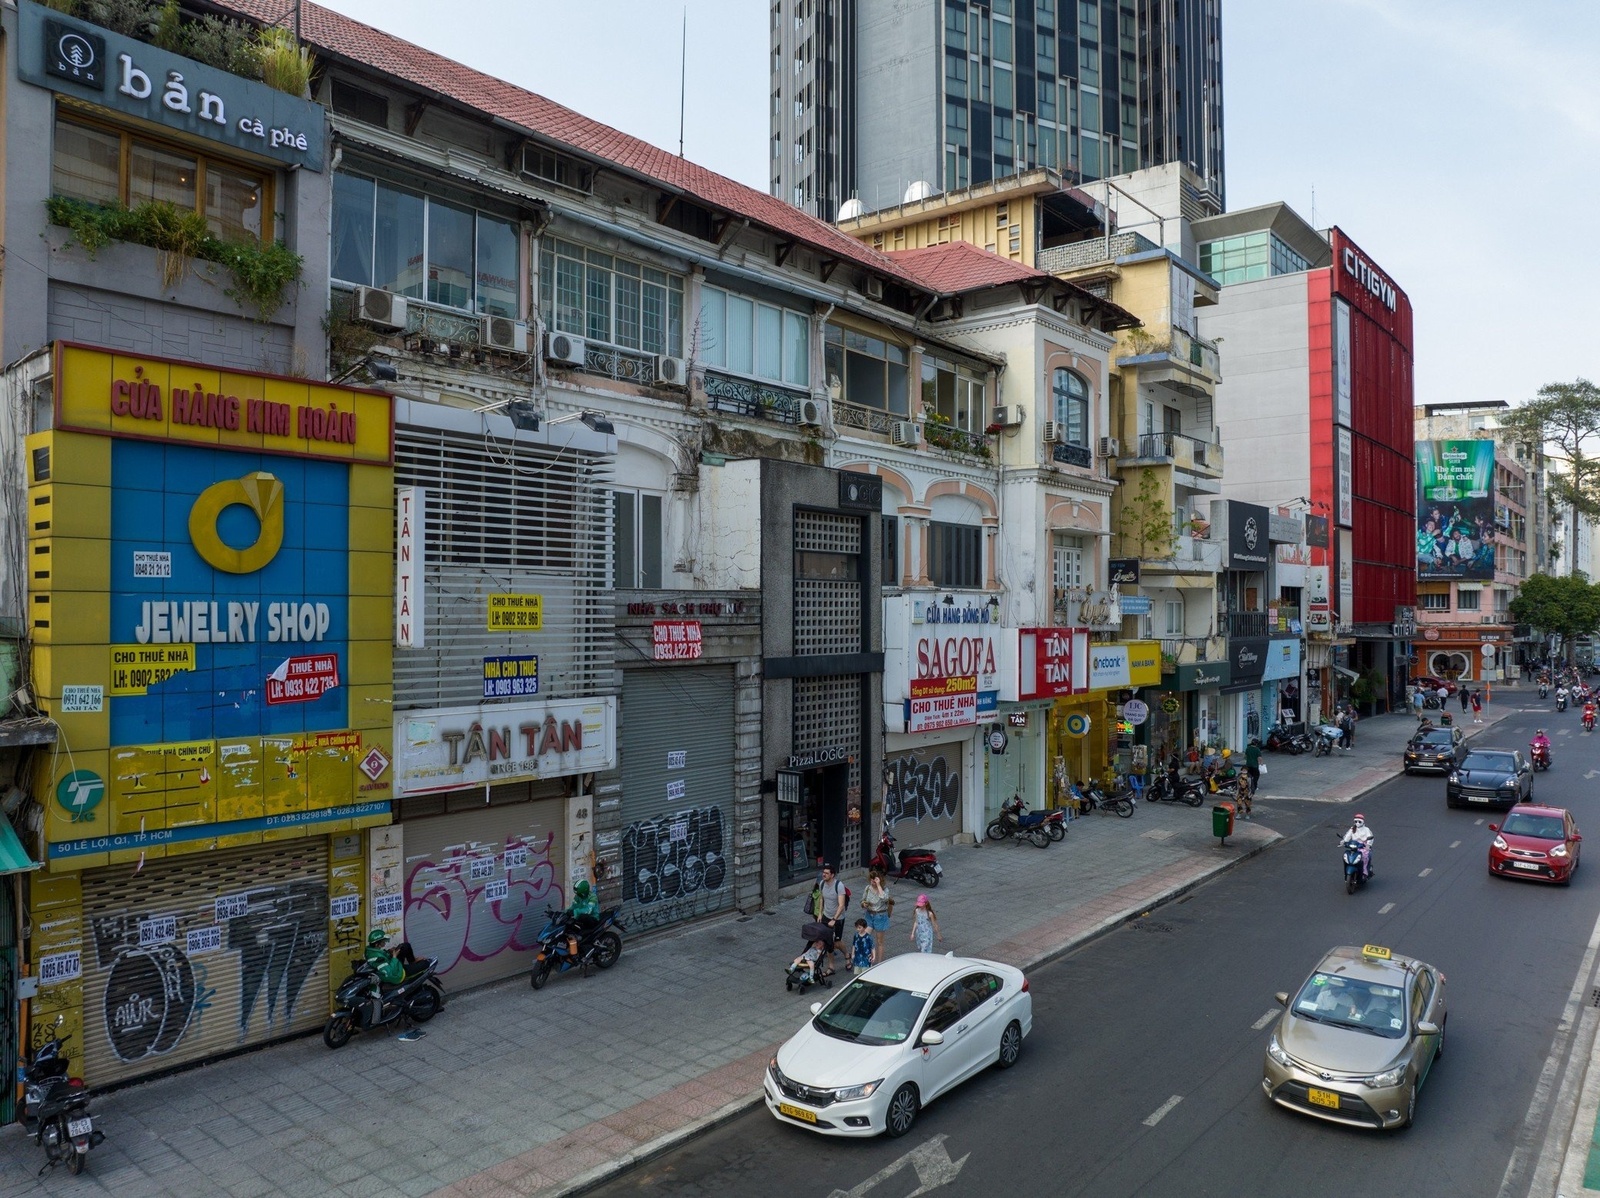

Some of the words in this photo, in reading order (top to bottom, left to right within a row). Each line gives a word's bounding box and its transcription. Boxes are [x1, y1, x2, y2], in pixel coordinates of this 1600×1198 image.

[119, 54, 227, 125] bản
[238, 116, 265, 138] cà
[269, 127, 308, 152] phê
[1343, 247, 1397, 313] CITIGYM
[111, 365, 163, 421] CỬA
[172, 384, 239, 431] HÀNG
[247, 398, 290, 436] KIM
[297, 402, 357, 444] HOÀN
[1434, 466, 1449, 474] Nhẹ
[401, 497, 411, 562] TÂN
[146, 553, 158, 561] THUÊ
[400, 574, 410, 642] TÂN
[492, 597, 506, 606] CHO
[507, 596, 523, 606] THUÊ
[525, 597, 538, 607] NHÀ
[135, 600, 260, 644] JEWELRY
[267, 602, 330, 643] SHOP
[654, 625, 667, 641] CHO
[669, 622, 685, 641] THUÊ
[686, 621, 701, 641] NHÀ
[1044, 632, 1069, 657] TÂN
[114, 651, 136, 663] CHO
[139, 649, 164, 662] THUÊ
[167, 648, 189, 661] NHÀ
[917, 637, 997, 679] SAGOFA
[1145, 659, 1155, 667] BANK
[291, 660, 313, 674] THUÊ
[315, 658, 333, 671] NHÀ
[485, 658, 501, 678] NHÀ
[502, 661, 518, 677] CHO
[519, 657, 537, 676] THUÊ
[1044, 658, 1069, 683] TÂN
[114, 669, 128, 688] LH:
[130, 668, 151, 687] 0902
[271, 681, 284, 699] LH:
[284, 679, 303, 697] 0933
[305, 677, 319, 694] 422
[496, 679, 511, 695] 0903
[513, 679, 524, 694] 963
[525, 678, 537, 693] 325
[946, 677, 976, 692] 250m2
[63, 694, 78, 705] 0931
[79, 694, 90, 705] 642
[91, 694, 101, 704] 166
[77, 686, 90, 694] THUÊ
[913, 702, 931, 714] CHO
[934, 696, 954, 711] THUÊ
[958, 694, 974, 708] NHÀ
[1011, 714, 1025, 723] TÂN
[178, 745, 198, 755] CHÍNH
[199, 743, 211, 754] CHỦ
[293, 737, 304, 748] CHO
[305, 736, 317, 748] THUÊ
[319, 734, 330, 746] NHÀ
[330, 732, 345, 745] CHÍNH
[346, 731, 357, 744] CHỦ
[442, 720, 511, 765] TÂN
[520, 713, 583, 756] TÂN
[789, 755, 814, 767] Pizza
[267, 817, 280, 825] ĐT:
[356, 803, 385, 812] 8227107
[576, 808, 588, 819] 48
[58, 843, 70, 852] 50
[74, 840, 87, 850] LÊ
[92, 838, 112, 848] LỢI,
[134, 833, 147, 842] TP.
[150, 831, 173, 840] HCM
[141, 925, 175, 942] 0931.432.469
[188, 935, 220, 952] 0906.905.006
[42, 958, 80, 978] 0925.45.47.47
